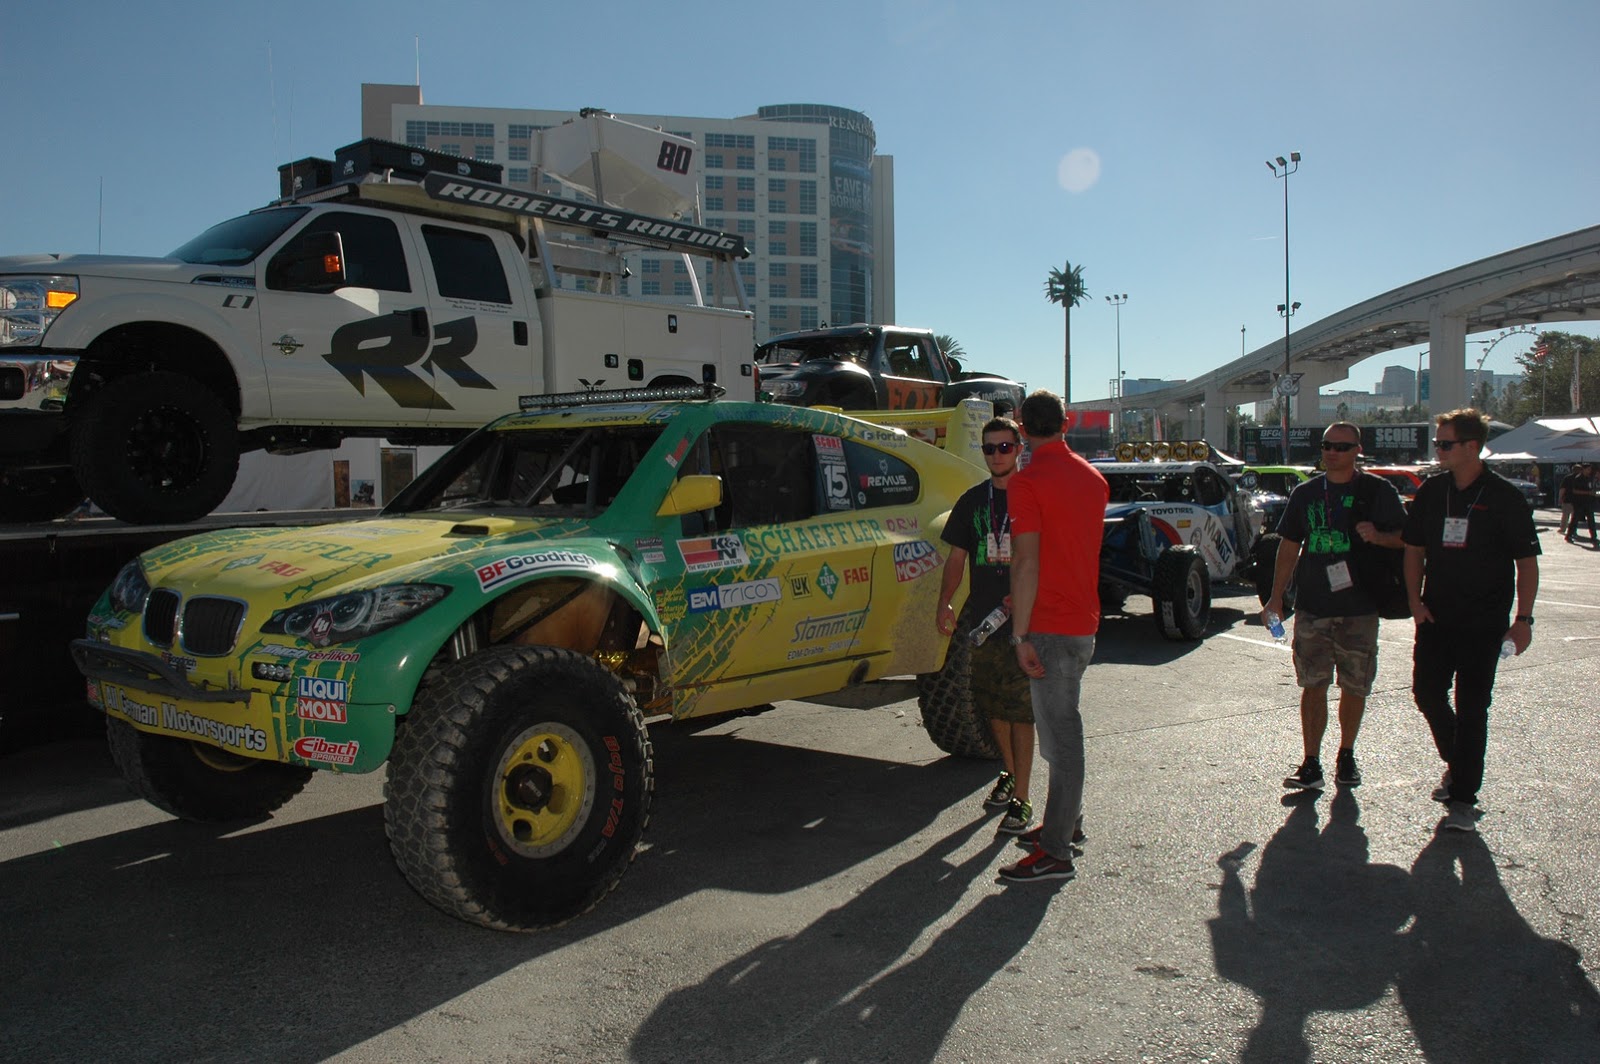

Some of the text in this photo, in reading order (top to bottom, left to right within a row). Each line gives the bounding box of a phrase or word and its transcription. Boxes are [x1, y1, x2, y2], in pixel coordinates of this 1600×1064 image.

[657, 140, 692, 175] 80
[438, 182, 737, 249] ROBERTS RACING
[886, 378, 946, 410] FOX
[815, 436, 842, 449] SCORE
[1260, 429, 1311, 438] BFGdrich
[1375, 428, 1418, 442] SCORE
[823, 465, 849, 498] 15
[867, 475, 907, 487] REMUS
[1151, 507, 1174, 515] TOYO
[746, 518, 886, 560] SCHAEFFLER
[894, 541, 936, 563] LIQUI
[256, 560, 306, 577] FAG
[477, 551, 597, 583] BFGoodrich
[843, 566, 869, 585] FAG
[896, 552, 942, 581] MOLY
[300, 678, 345, 700] LIQUI
[104, 684, 120, 711] All
[161, 701, 267, 752] Motorsports
[301, 699, 345, 720] MOLY
[295, 738, 358, 758] Eibach
[310, 752, 351, 763] SPRINGS
[601, 736, 626, 838] Baja T/A
